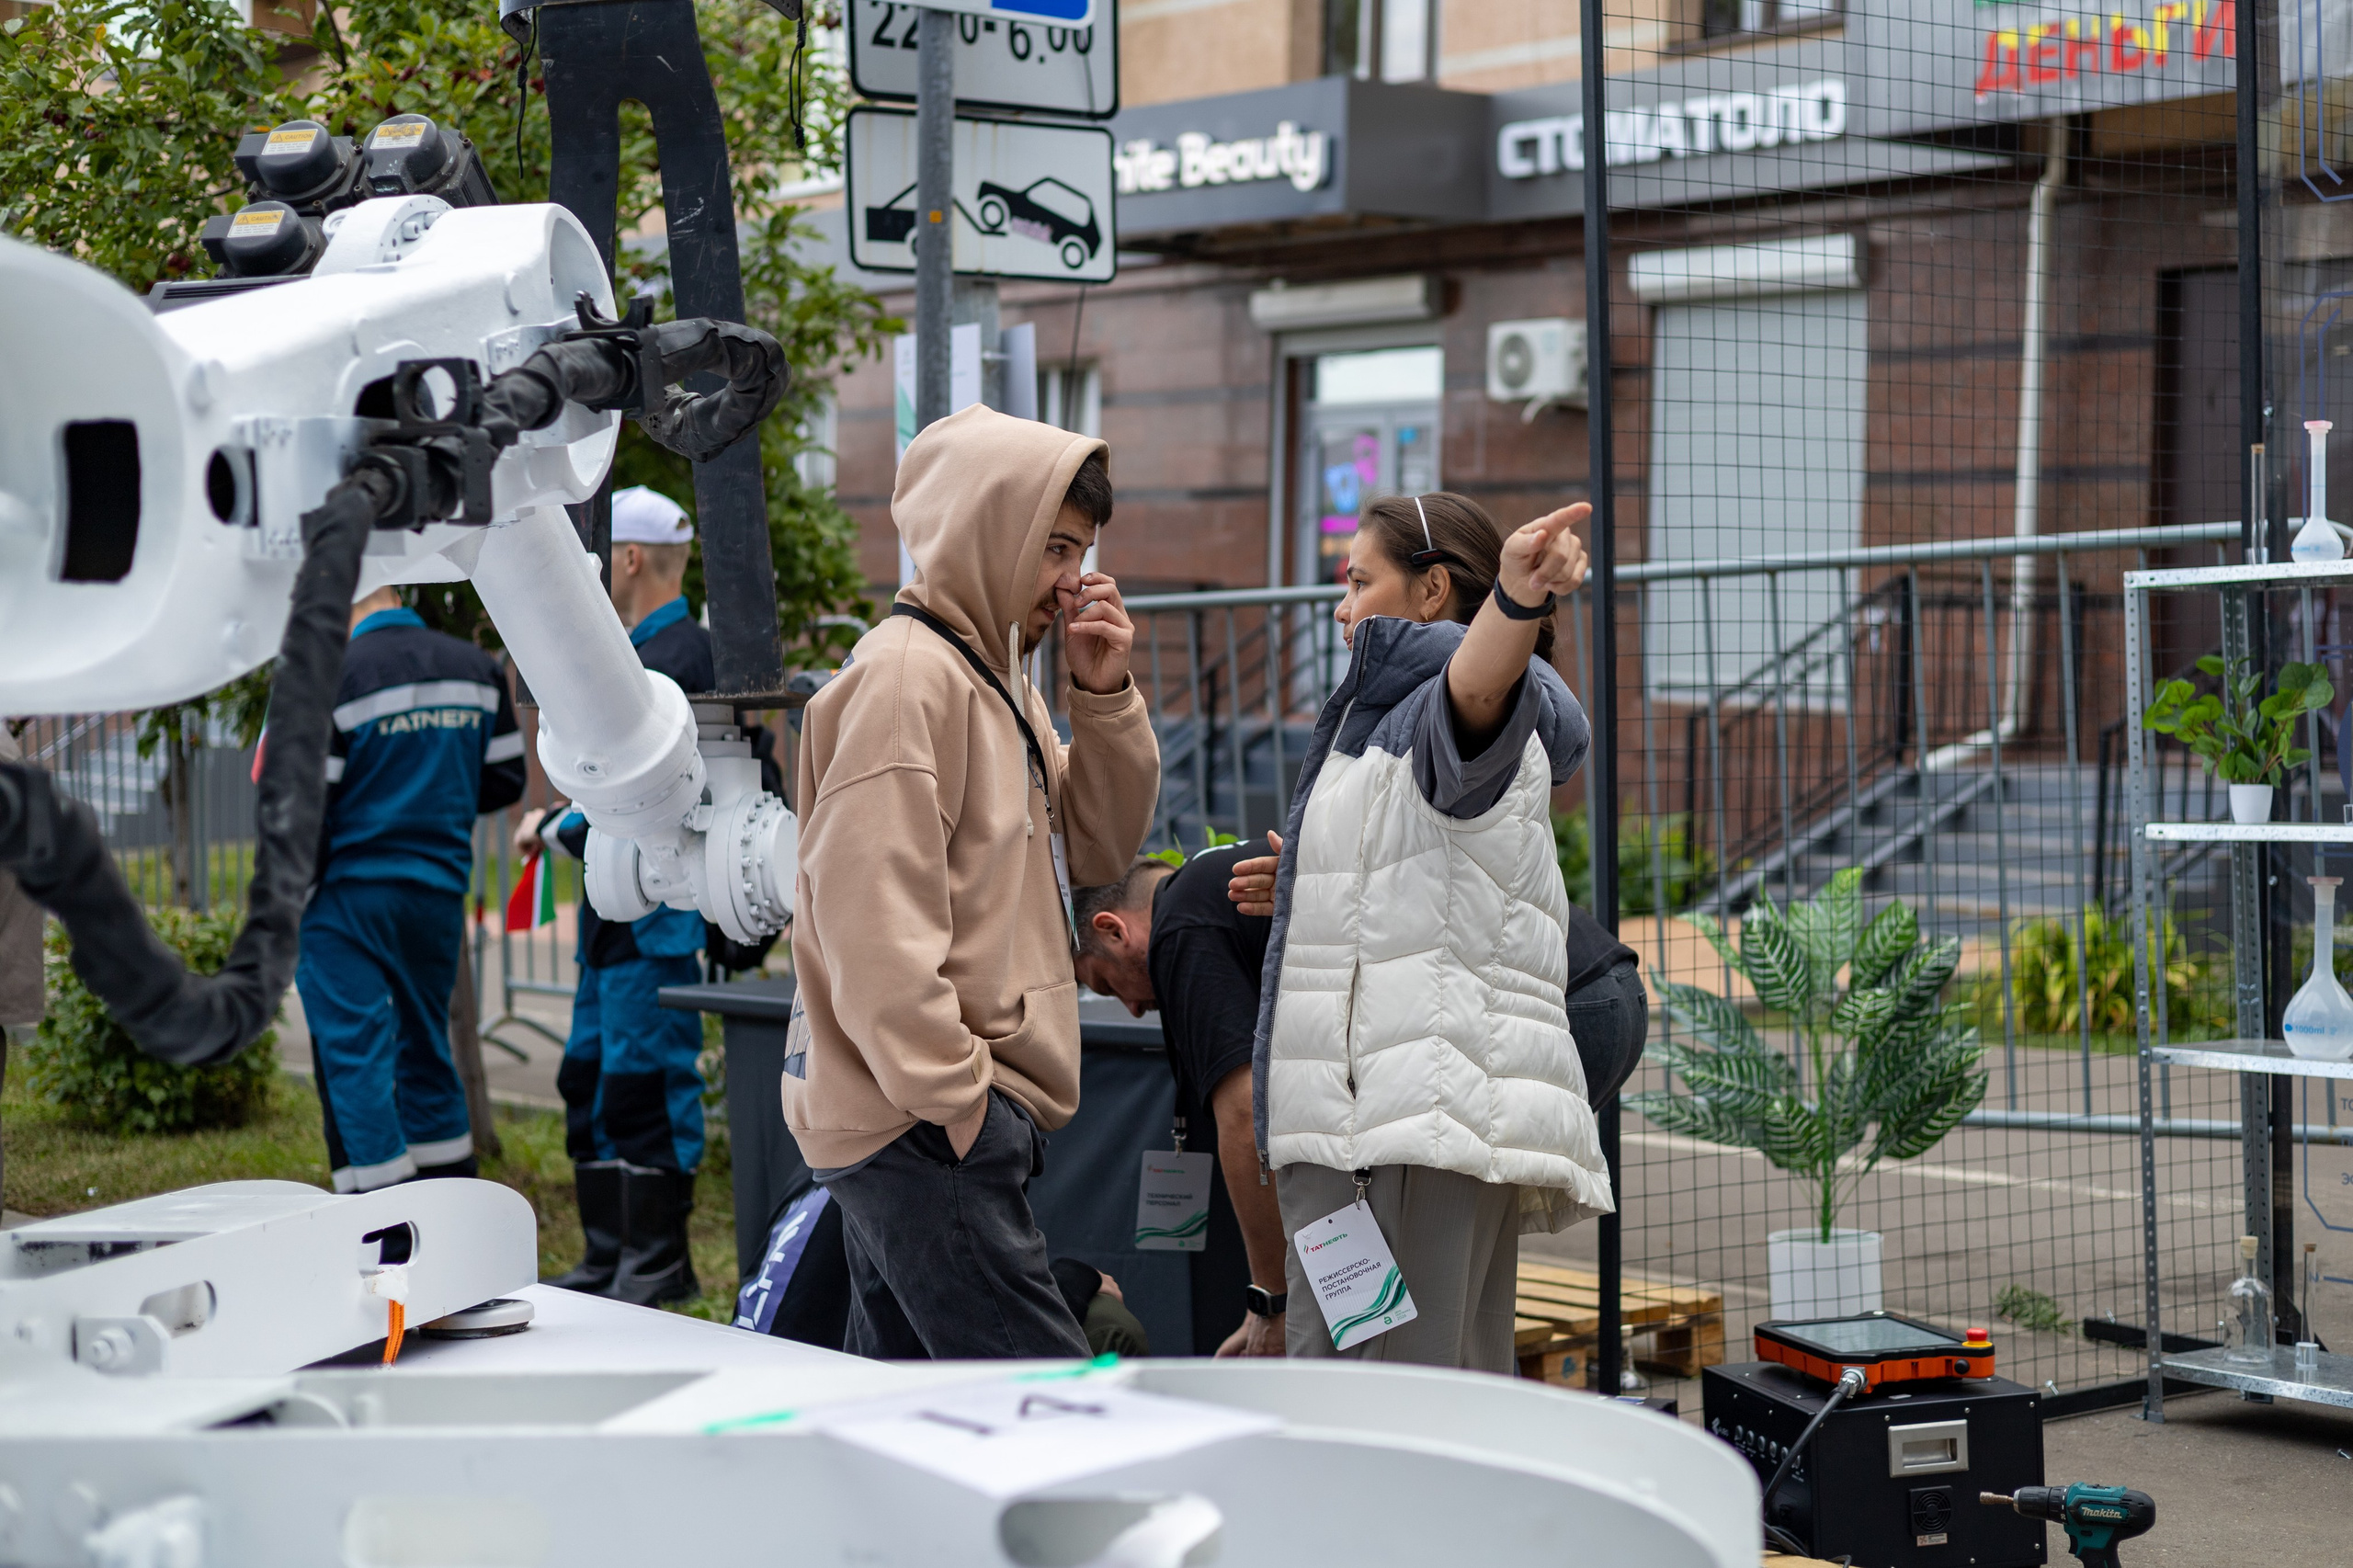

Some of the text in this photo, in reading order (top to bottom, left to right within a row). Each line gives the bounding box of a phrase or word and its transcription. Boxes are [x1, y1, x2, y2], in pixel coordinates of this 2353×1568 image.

[1974, 0, 2236, 96] ДЕНЬГИ
[1177, 120, 1325, 192] Beauty
[378, 709, 482, 735] TATNEFT
[1310, 1233, 1348, 1253] ТАТНЕФТЬ
[1318, 1258, 1370, 1284] РЕЖИССЕРСКО-
[1322, 1262, 1381, 1292] ПОСТАНОВОЧНАЯ
[1324, 1285, 1352, 1301] ГРУППА
